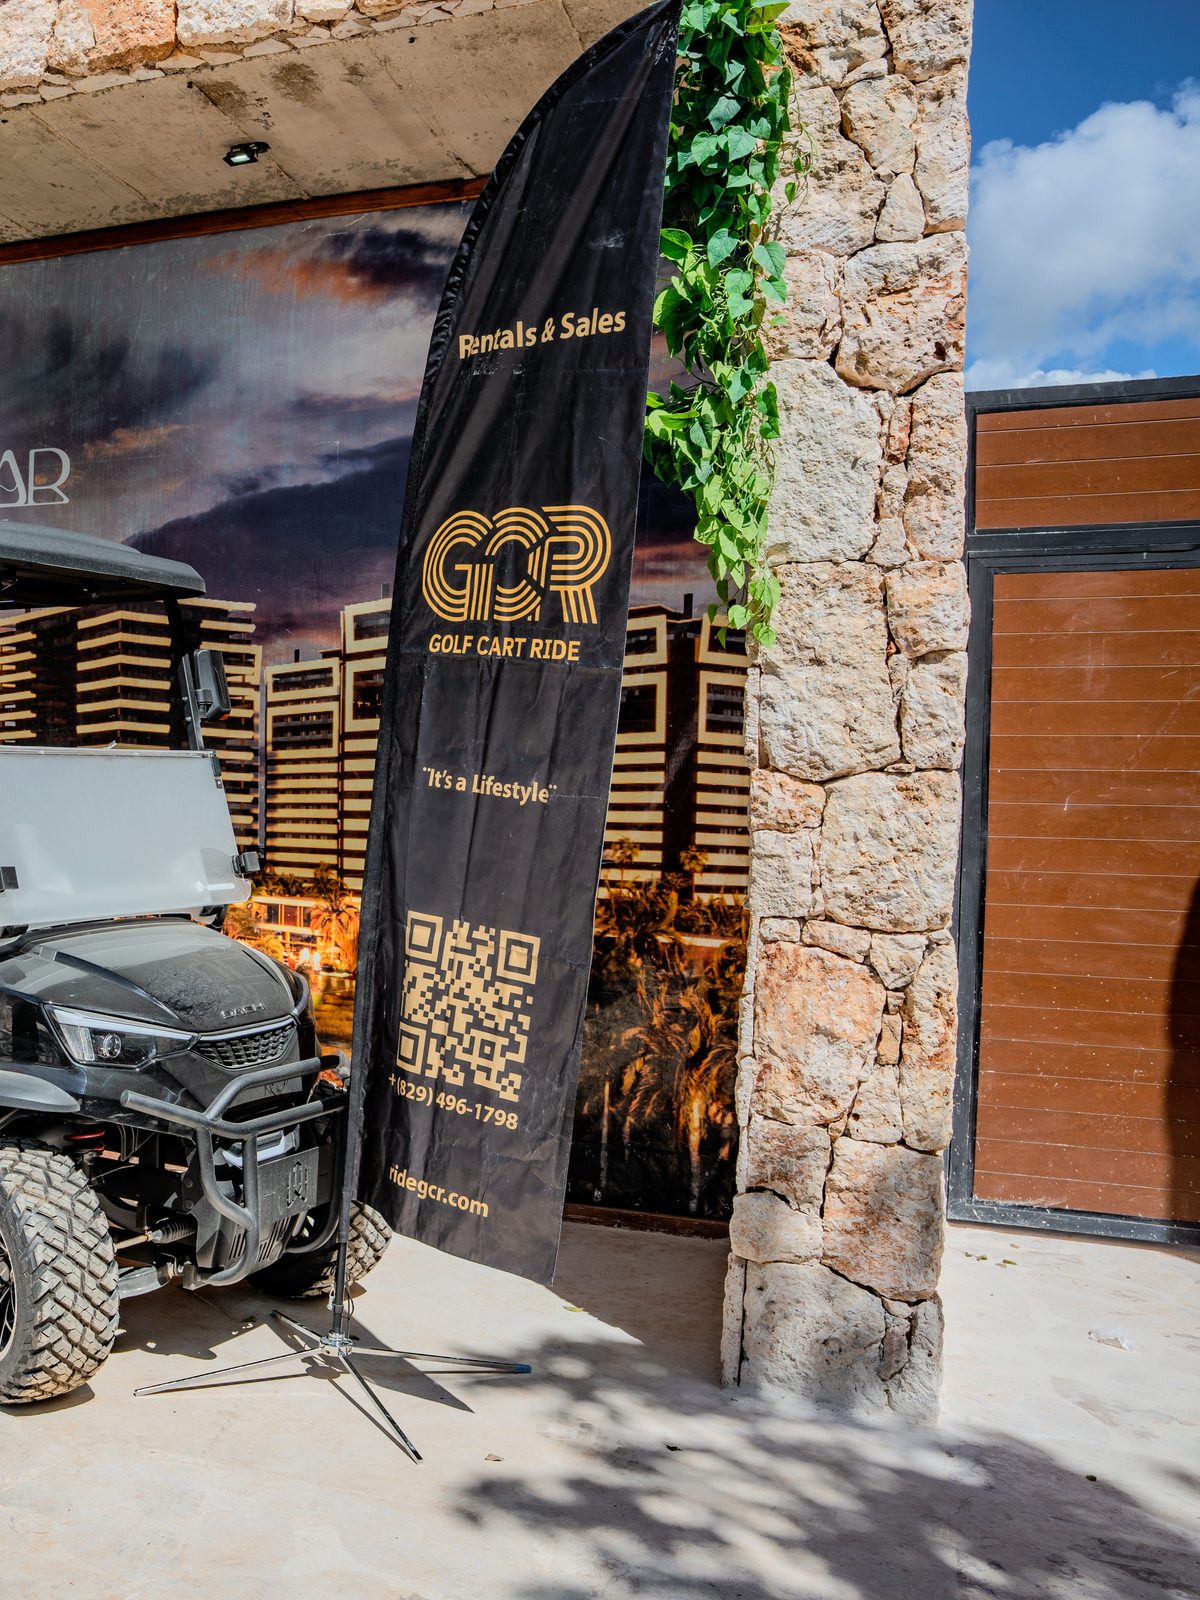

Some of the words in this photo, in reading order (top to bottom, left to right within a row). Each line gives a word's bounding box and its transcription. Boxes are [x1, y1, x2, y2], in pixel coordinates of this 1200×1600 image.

[458, 320, 537, 359] Rentals
[541, 317, 556, 343] &
[559, 307, 626, 339] Sales
[422, 504, 612, 625] GCR
[428, 633, 474, 654] GOLF
[477, 635, 527, 658] CART
[529, 638, 581, 662] RIDE
[455, 776, 467, 792] a
[389, 1164, 489, 1218] ridegcr.com
